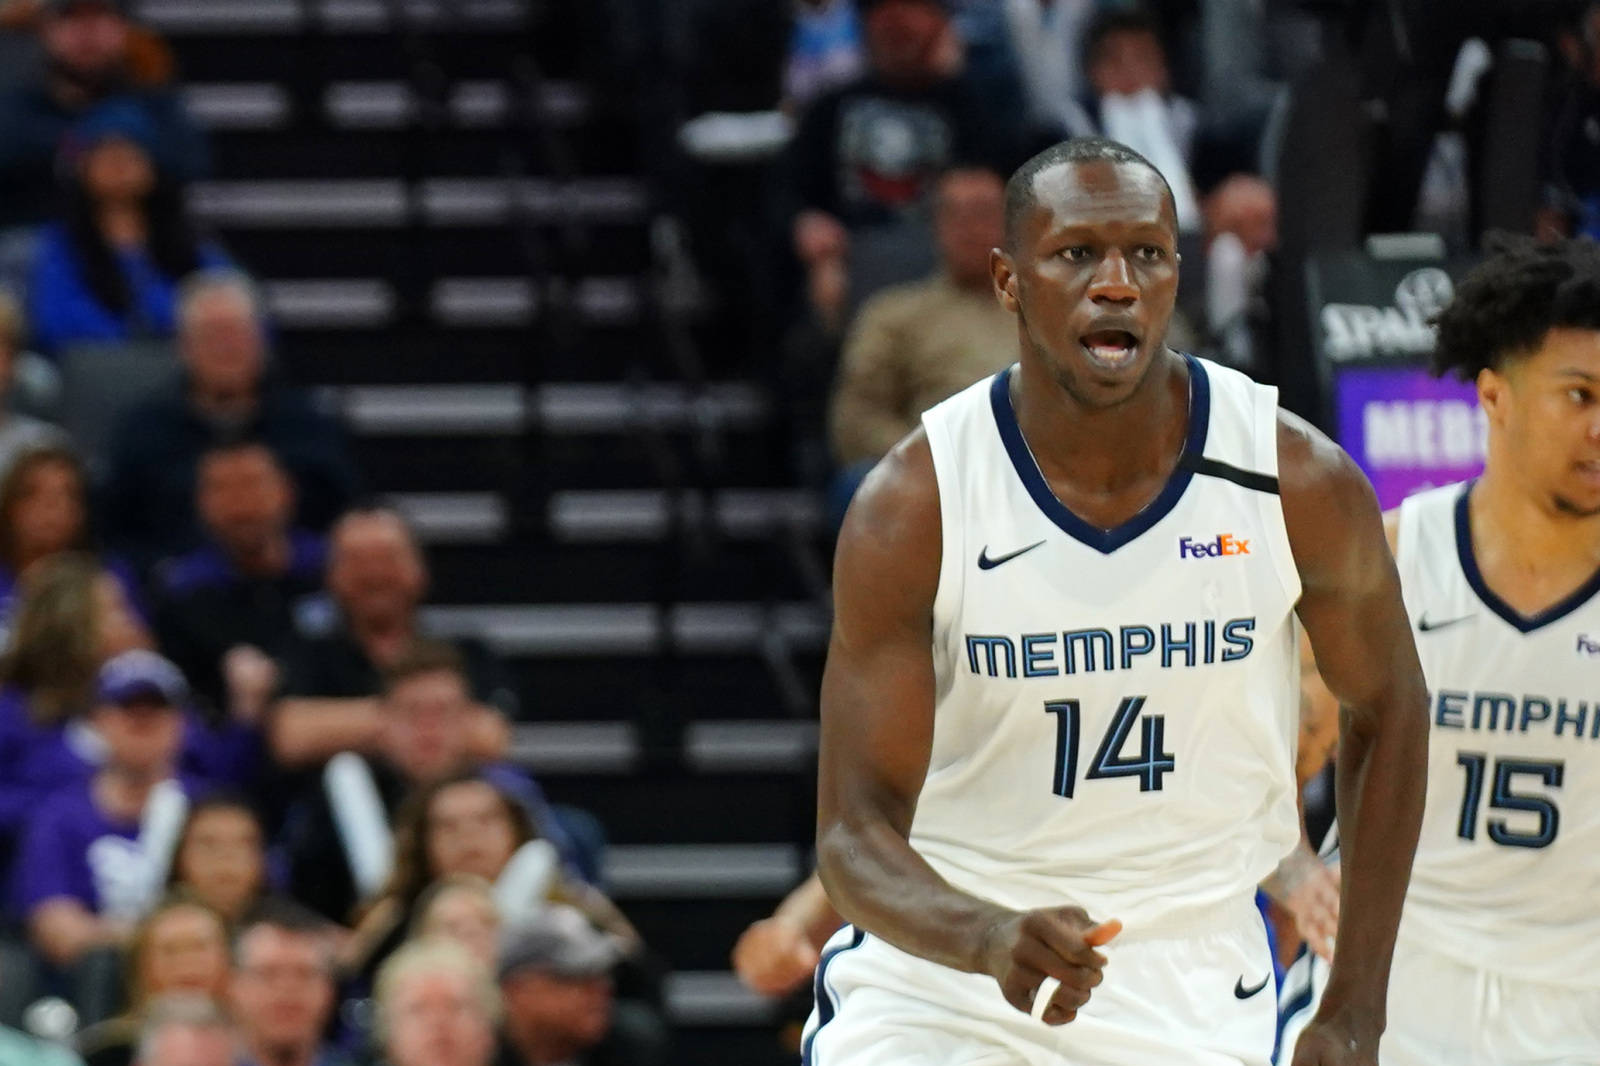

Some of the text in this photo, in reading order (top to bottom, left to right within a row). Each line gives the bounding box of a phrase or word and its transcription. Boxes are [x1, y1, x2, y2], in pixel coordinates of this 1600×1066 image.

[1179, 533, 1250, 559] FedEx
[965, 617, 1256, 678] MEMPHIS
[1429, 689, 1600, 739] EMPHI
[1044, 696, 1175, 799] 14
[1456, 750, 1566, 849] 15
